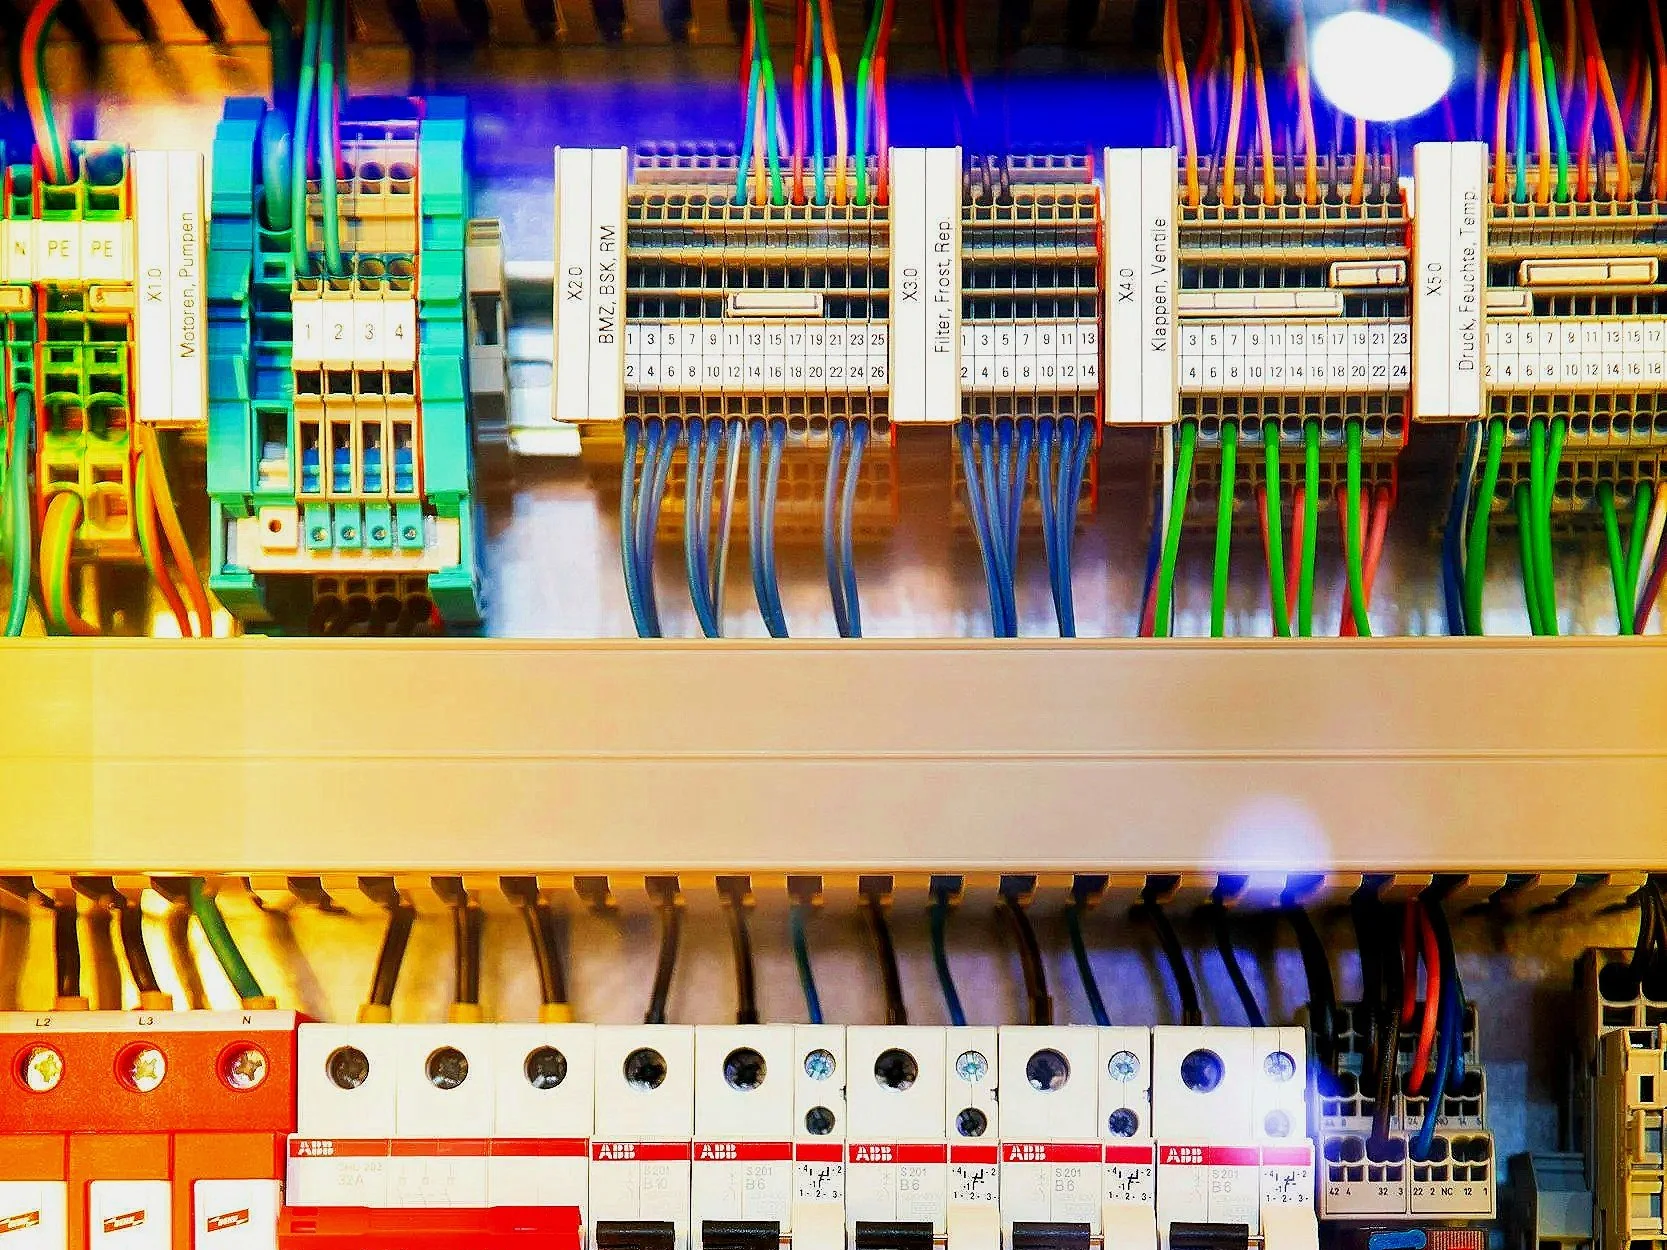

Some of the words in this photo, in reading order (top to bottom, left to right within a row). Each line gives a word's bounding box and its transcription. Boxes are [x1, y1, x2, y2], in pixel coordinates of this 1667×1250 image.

[599, 225, 615, 252] RM
[934, 217, 953, 253] Rep.
[48, 240, 70, 257] PE
[91, 240, 113, 257] PE
[179, 212, 196, 278] Pumpen
[567, 266, 583, 301] X2.0
[599, 258, 617, 295] BSK,
[934, 259, 952, 303] Frost,
[902, 268, 918, 302] X3.0
[1119, 268, 1134, 303] X4.0
[180, 284, 196, 358] Motoren,
[598, 301, 617, 344] BMZ,
[1150, 280, 1170, 352] Klappen,
[335, 324, 343, 339] 2
[365, 324, 374, 339] 3
[394, 324, 404, 339] 4
[934, 308, 952, 353] Filter,
[749, 334, 761, 345] 13
[770, 334, 782, 345] 15
[790, 334, 801, 345] 17
[811, 334, 822, 345] 19
[830, 334, 841, 345] 21
[850, 334, 864, 345] 23
[871, 334, 884, 345] 25
[1061, 334, 1072, 345] 11
[1082, 334, 1095, 345] 13
[708, 366, 719, 377] 10
[728, 366, 740, 377] 12
[749, 366, 760, 377] 14
[770, 366, 782, 377] 16
[790, 366, 801, 377] 18
[809, 366, 822, 377] 20
[830, 366, 842, 377] 22
[850, 366, 864, 377] 24
[871, 366, 884, 377] 26
[1041, 366, 1053, 378] 10
[1061, 366, 1074, 378] 12
[1082, 366, 1095, 378] 14
[1333, 366, 1344, 377] 18
[1352, 366, 1366, 377] 20
[1373, 366, 1385, 377] 22
[1393, 366, 1407, 377] 24
[1566, 364, 1578, 375] 10
[1587, 364, 1598, 375] 12
[1607, 364, 1619, 375] 14
[1628, 364, 1640, 375] 16
[1649, 364, 1660, 375] 18
[35, 1018, 51, 1027] L2
[138, 1016, 154, 1026] L3
[242, 1016, 251, 1025] N
[298, 1140, 334, 1156] ABB
[598, 1144, 636, 1160] ABB
[700, 1144, 737, 1160] ABB
[855, 1146, 893, 1162] ABB
[1009, 1145, 1046, 1161] ABB
[1166, 1148, 1203, 1164] ABB
[1378, 1188, 1388, 1196] 32
[1413, 1188, 1423, 1196] 22
[1463, 1188, 1472, 1196] 12
